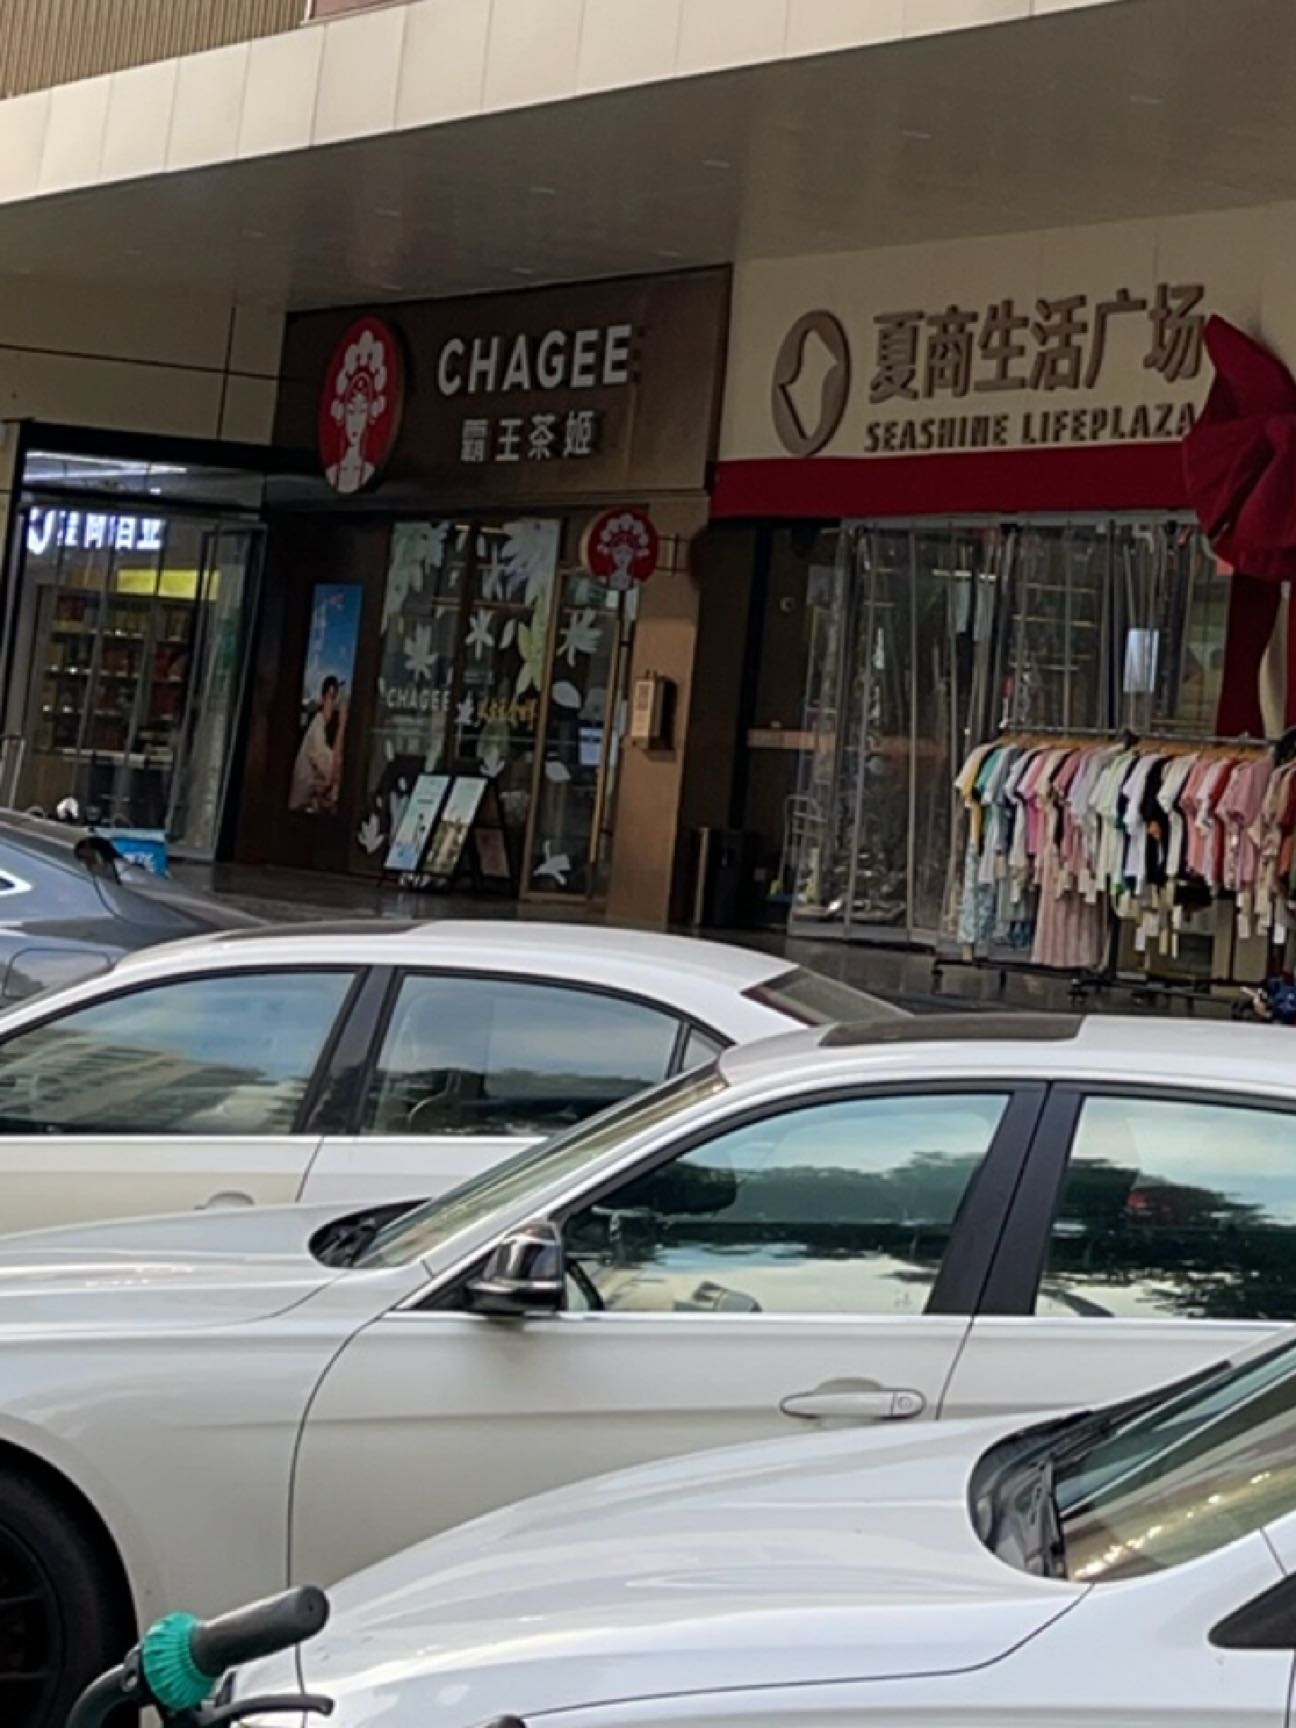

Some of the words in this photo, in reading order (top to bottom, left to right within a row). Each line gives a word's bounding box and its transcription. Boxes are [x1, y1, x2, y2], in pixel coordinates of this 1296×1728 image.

[437, 324, 633, 396] CHAGEE
[869, 283, 1205, 404] 夏商生活广场
[460, 409, 595, 463] 霸王茶姬
[864, 410, 1008, 453] SEASHINE
[1022, 402, 1196, 445] LIFEPLAZA
